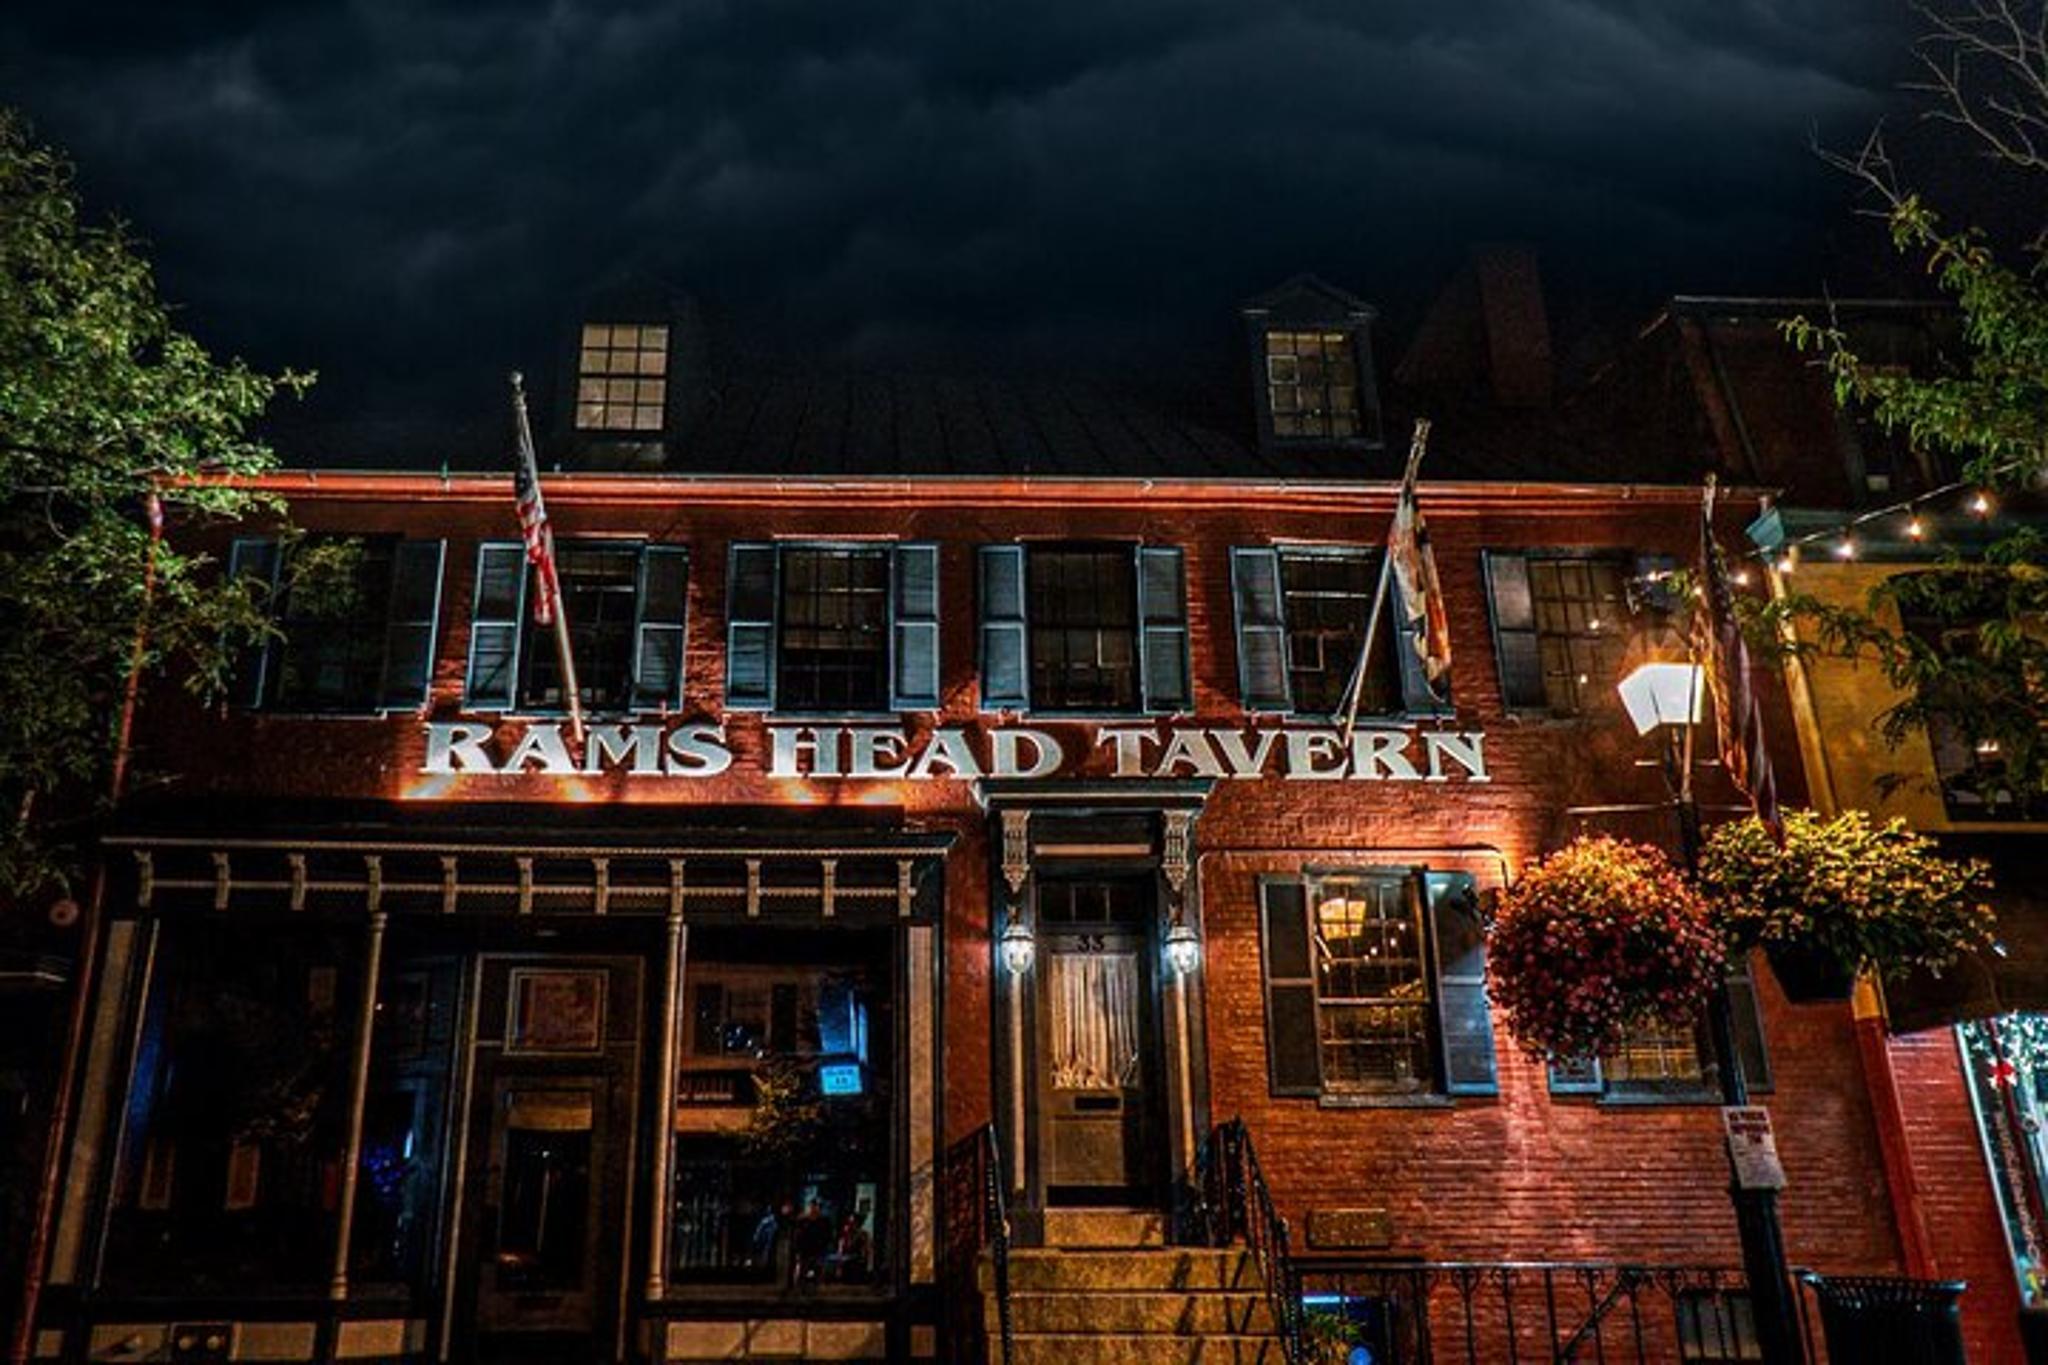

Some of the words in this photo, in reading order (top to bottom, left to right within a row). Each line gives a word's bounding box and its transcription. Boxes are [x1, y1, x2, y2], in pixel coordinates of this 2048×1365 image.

[419, 721, 733, 777] RAMS
[767, 727, 1064, 779] HEAD
[1096, 727, 1492, 782] TAVERN
